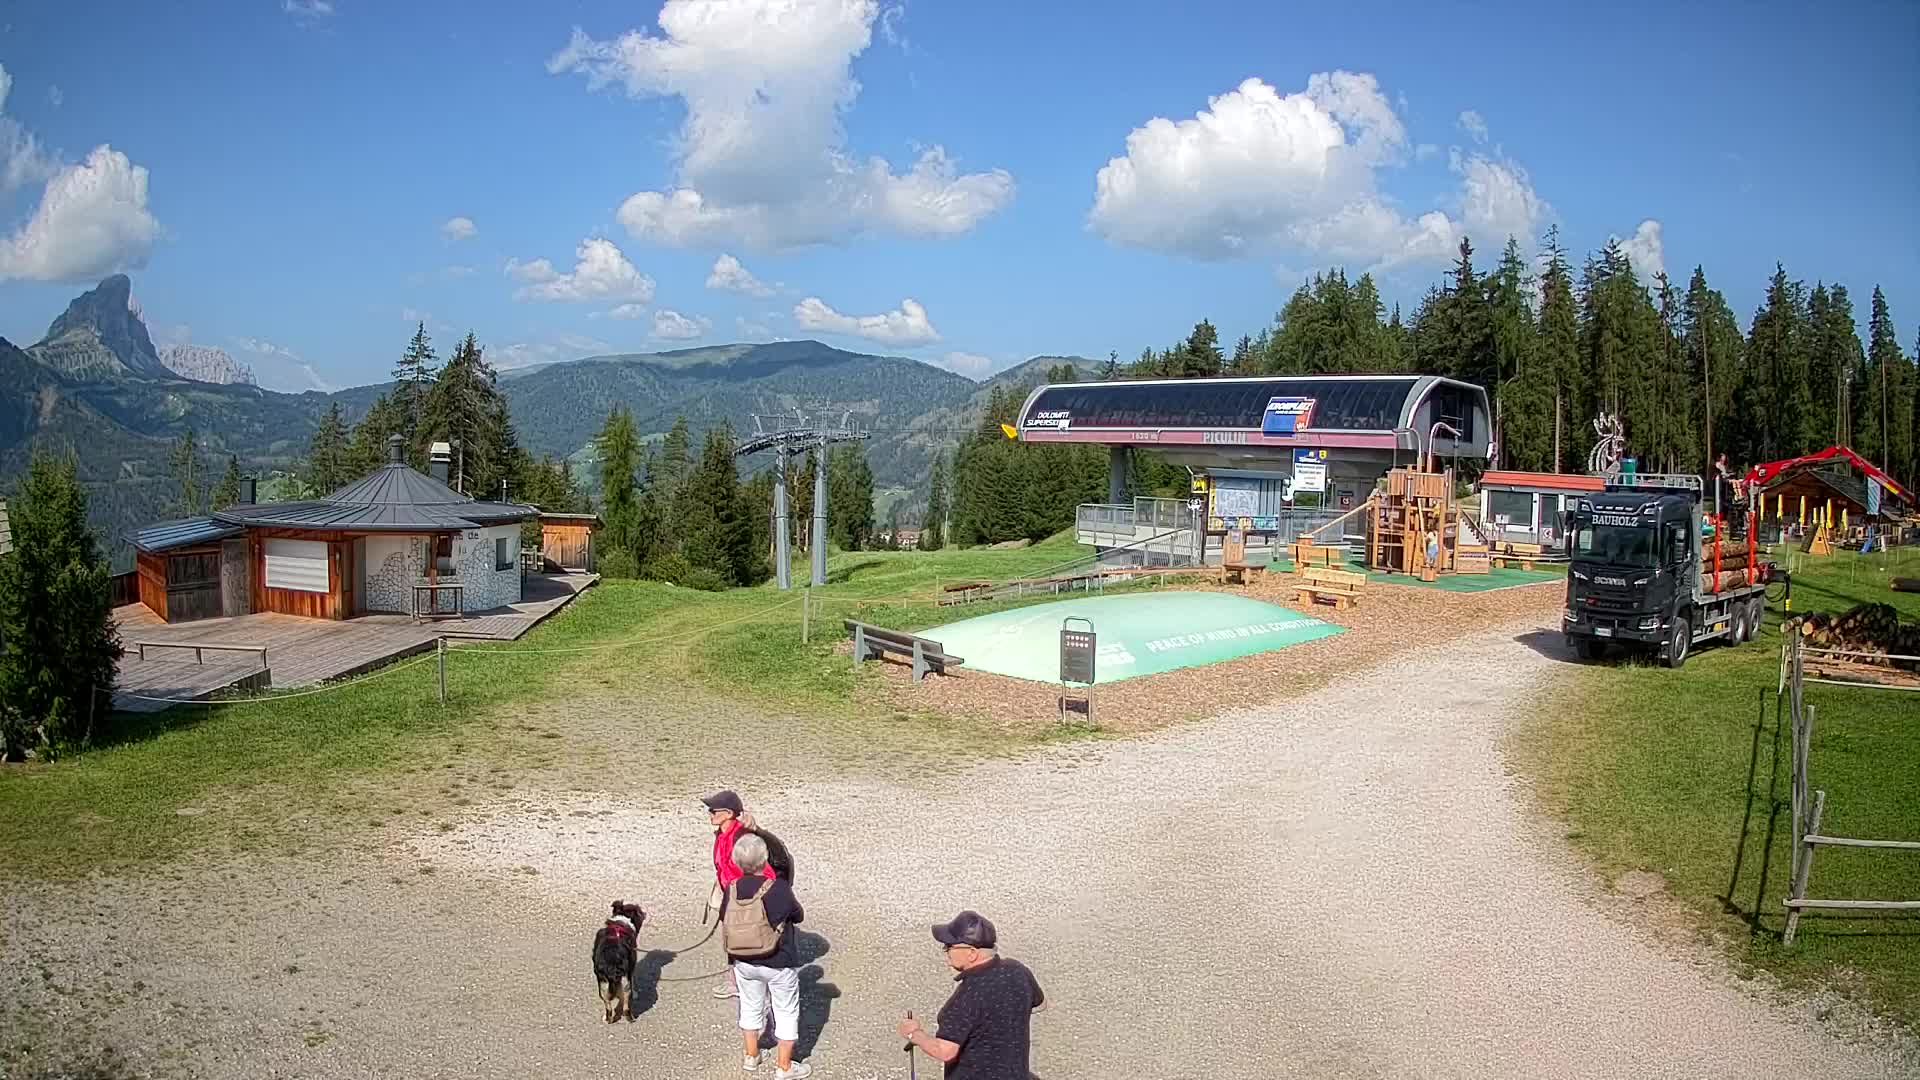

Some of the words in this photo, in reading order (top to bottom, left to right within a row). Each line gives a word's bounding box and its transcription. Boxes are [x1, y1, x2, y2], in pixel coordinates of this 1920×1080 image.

[1203, 431, 1246, 444] PICULIN
[1591, 514, 1639, 527] BAUHOLZ
[1594, 576, 1626, 587] SCANIA
[1146, 636, 1190, 652] PEACE
[1188, 632, 1204, 647] OF
[1206, 628, 1237, 641] MIND
[1248, 623, 1271, 635] ALL
